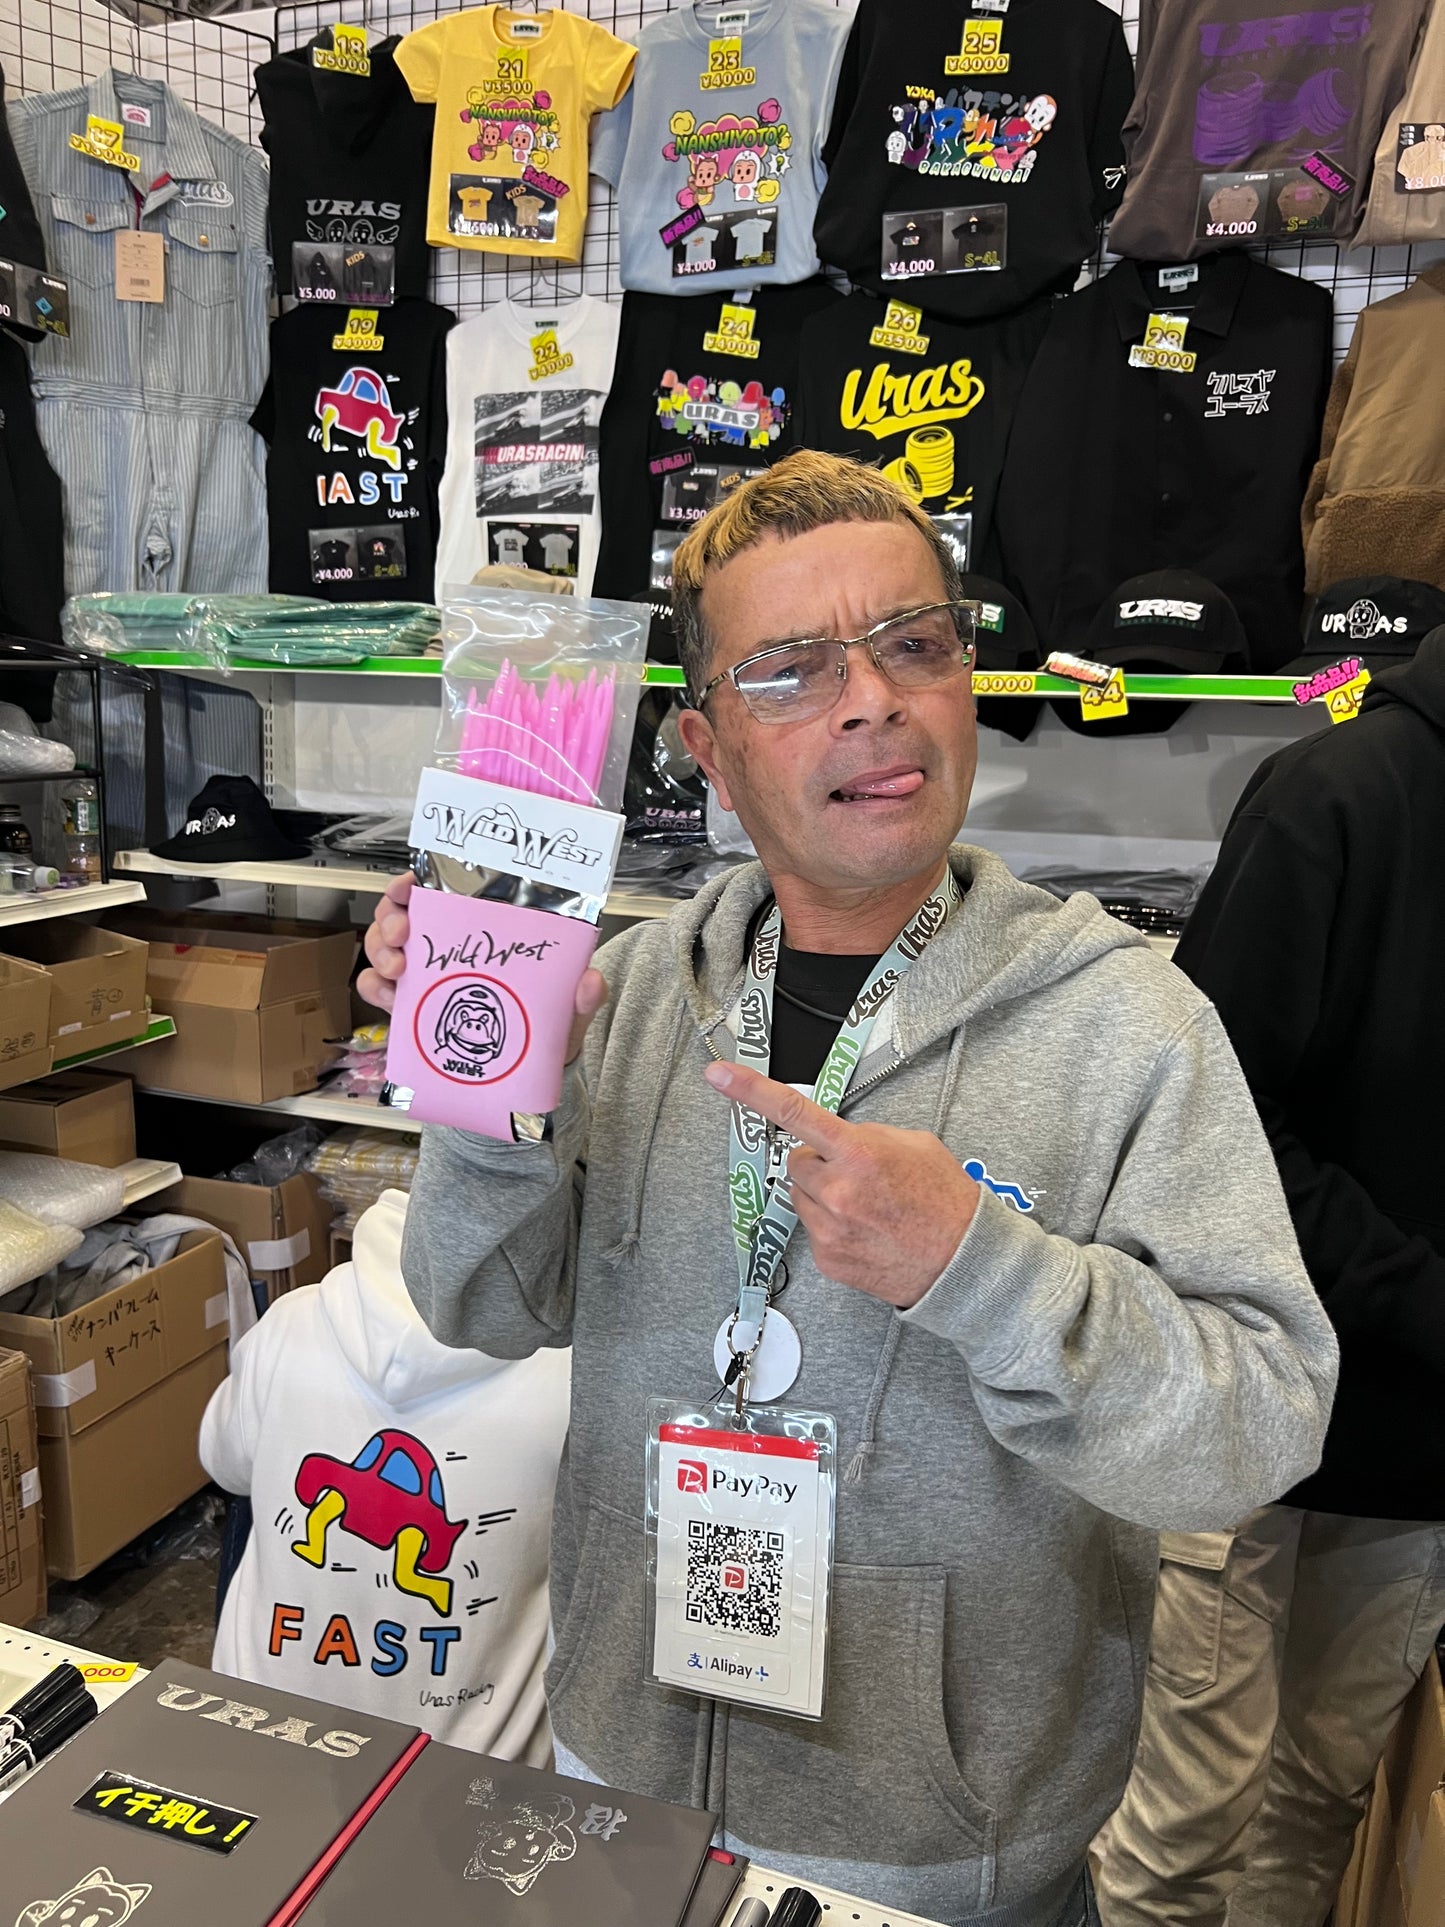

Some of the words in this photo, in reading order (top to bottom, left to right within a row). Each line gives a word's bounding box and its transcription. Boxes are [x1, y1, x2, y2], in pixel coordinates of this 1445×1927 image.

[1199, 3, 1374, 56] URAS
[336, 35, 364, 58] 18
[965, 32, 997, 54] 25
[316, 50, 369, 74] ¥5000
[498, 58, 523, 78] 21
[711, 51, 739, 71] 23
[947, 56, 1008, 71] ¥4000
[483, 80, 532, 94] ¥3500
[701, 69, 755, 88] ¥4000
[676, 124, 788, 155] NANSHIYOTO?
[506, 184, 527, 200] KIDS
[306, 199, 401, 220] URAS
[1206, 221, 1257, 236] ¥4.000
[345, 251, 366, 267] KIDS
[677, 258, 716, 274] ¥4.000
[889, 259, 935, 275] ¥4.000
[299, 287, 336, 300] ¥5.000
[350, 318, 374, 334] 19
[722, 317, 749, 338] 24
[887, 309, 916, 331] 26
[333, 335, 382, 349] ¥4000
[706, 337, 759, 356] ¥4000
[873, 330, 927, 352] ¥3500
[1146, 327, 1182, 350] 28
[534, 341, 559, 364] 22
[1134, 348, 1194, 370] ¥8000
[529, 353, 574, 380] ¥4000
[1207, 369, 1276, 395] クルマヤ
[841, 359, 985, 440] Uras
[1204, 391, 1271, 418] ユーラス
[686, 404, 758, 427] URAS
[319, 568, 353, 580] ¥4.000
[1119, 599, 1204, 621] URAS
[1083, 681, 1124, 706] 44
[898, 895, 949, 962] Uras
[422, 933, 482, 971] Wild
[482, 930, 560, 967] West
[737, 987, 773, 1060] Uras
[746, 1218, 792, 1288] Ura
[713, 1469, 798, 1503] PayPay
[269, 1603, 461, 1677] FAST
[711, 1657, 753, 1679] Alipay
[157, 1682, 373, 1758] URAS
[95, 1786, 251, 1843] イチ押し!
